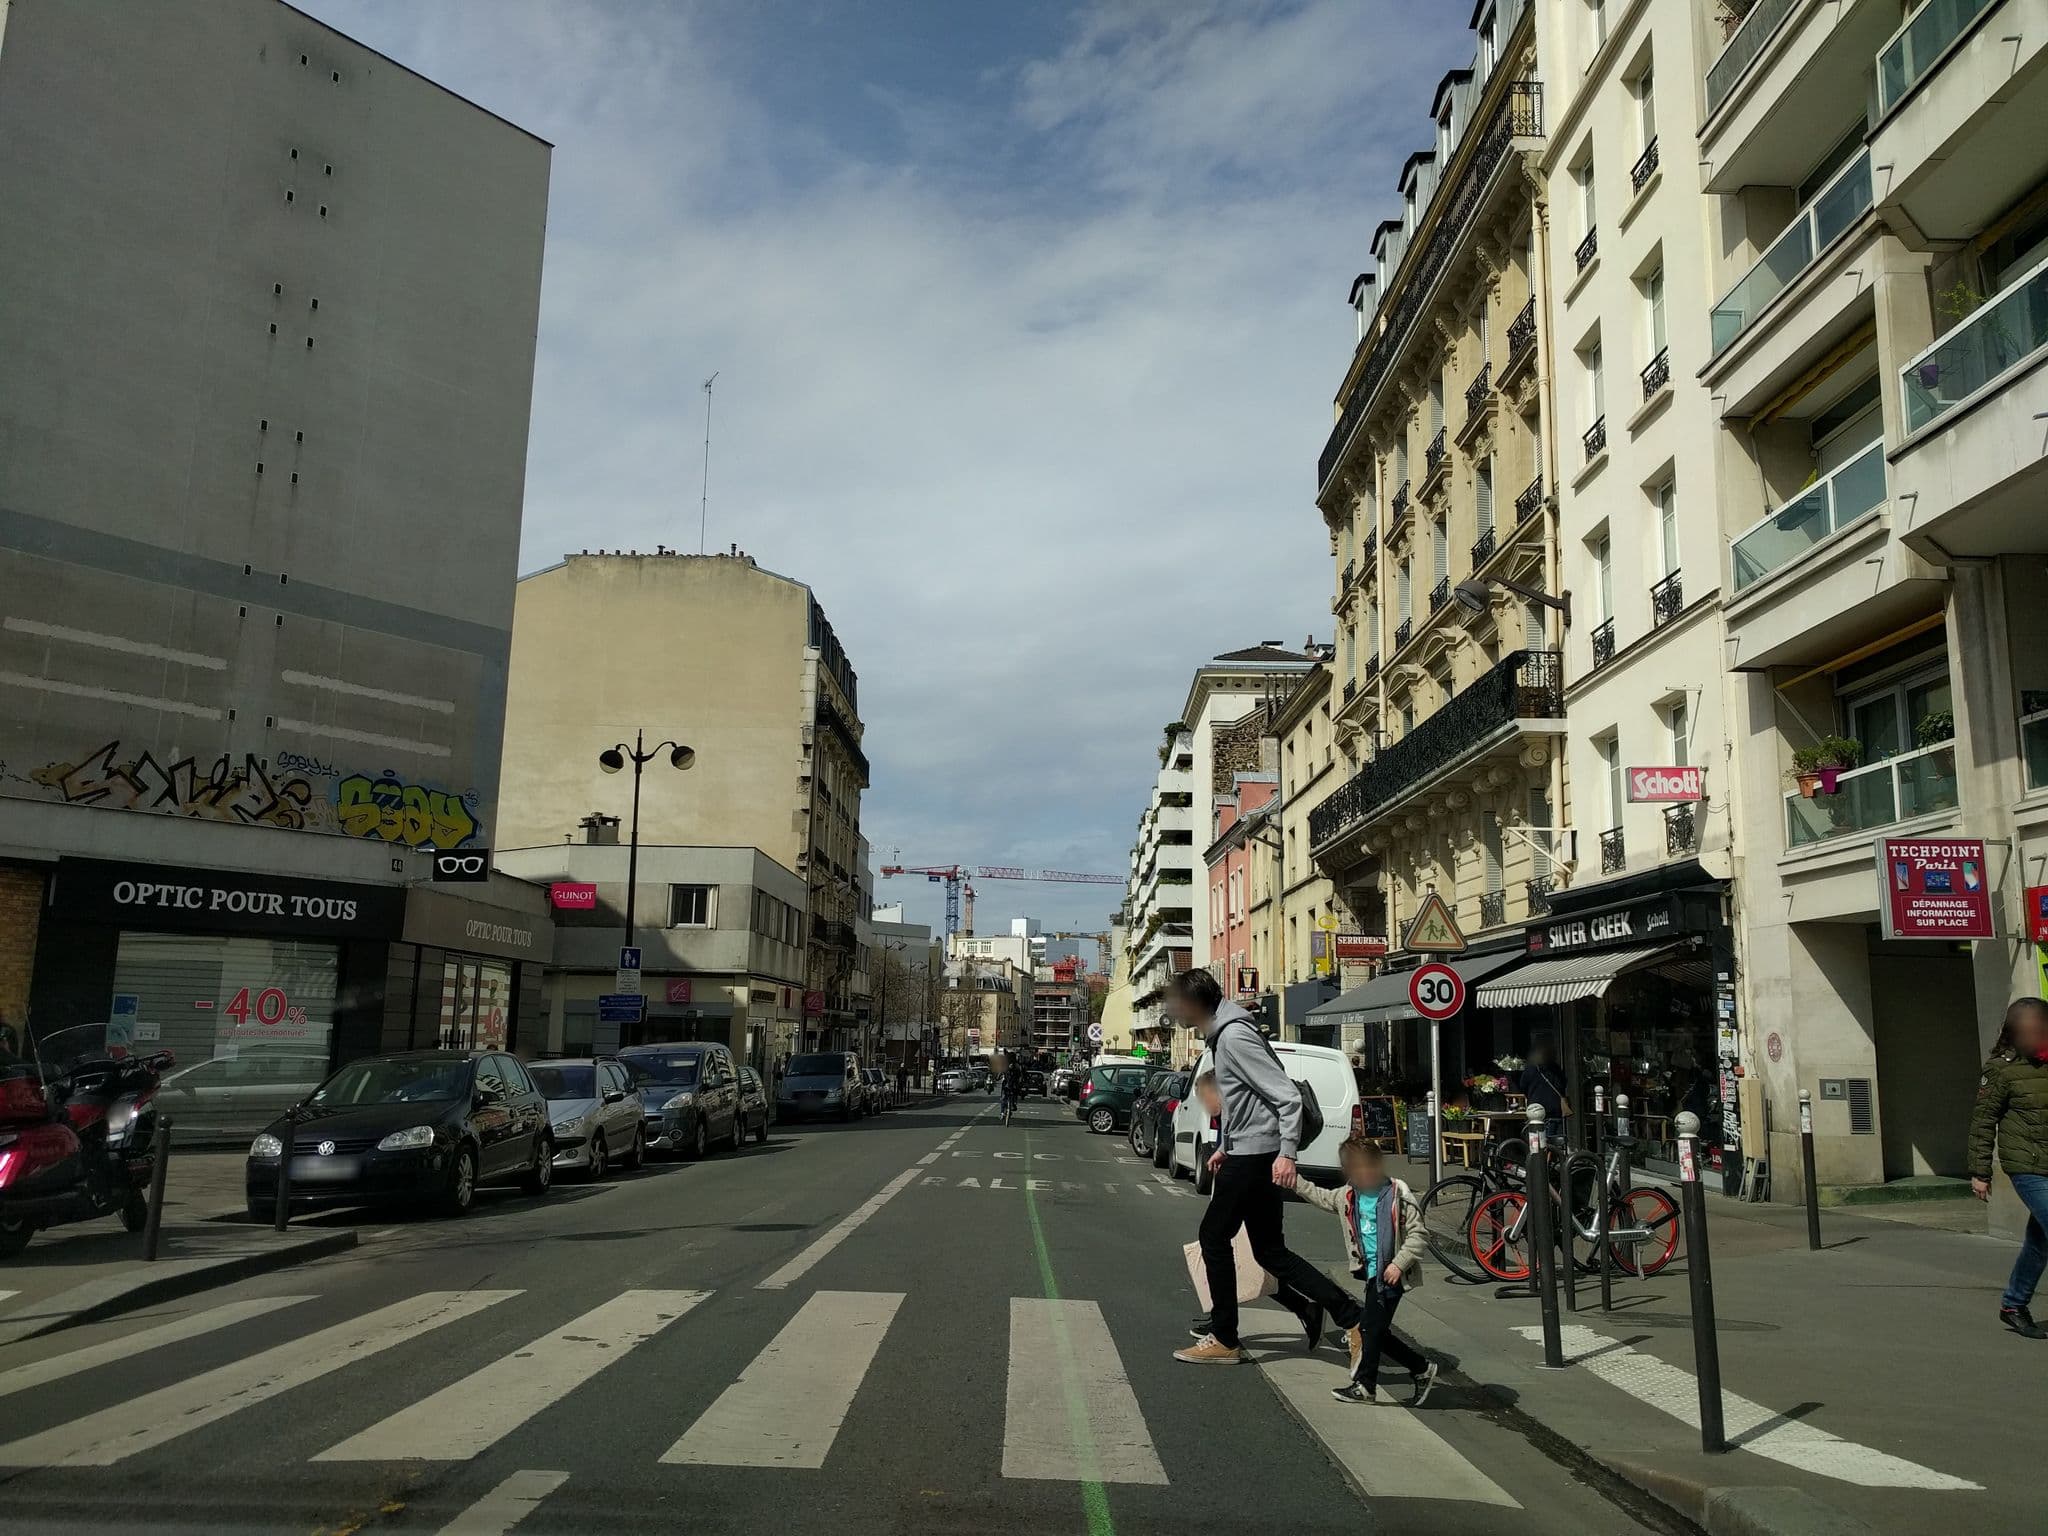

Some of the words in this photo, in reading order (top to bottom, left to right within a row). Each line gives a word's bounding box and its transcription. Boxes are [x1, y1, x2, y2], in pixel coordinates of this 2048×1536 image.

[1634, 771, 1699, 798] Schott
[1889, 846, 1980, 857] TECHPOINT
[1914, 859, 1958, 870] Paris
[113, 881, 203, 909] OPTIC
[209, 889, 285, 915] POUR
[291, 896, 357, 920] TOUS
[554, 890, 594, 900] GUINOT
[1912, 899, 1969, 908] DÉPANNAGE
[1907, 910, 1976, 918] INFORMATIQUE
[1916, 919, 1936, 927] SUR
[1938, 919, 1969, 927] PLACE
[466, 919, 492, 941] OPTIC
[492, 925, 513, 944] POUR
[514, 928, 532, 947] TOUS
[1549, 921, 1588, 948] SILVER
[1591, 911, 1633, 942] CREEK
[1420, 979, 1454, 1004] 30
